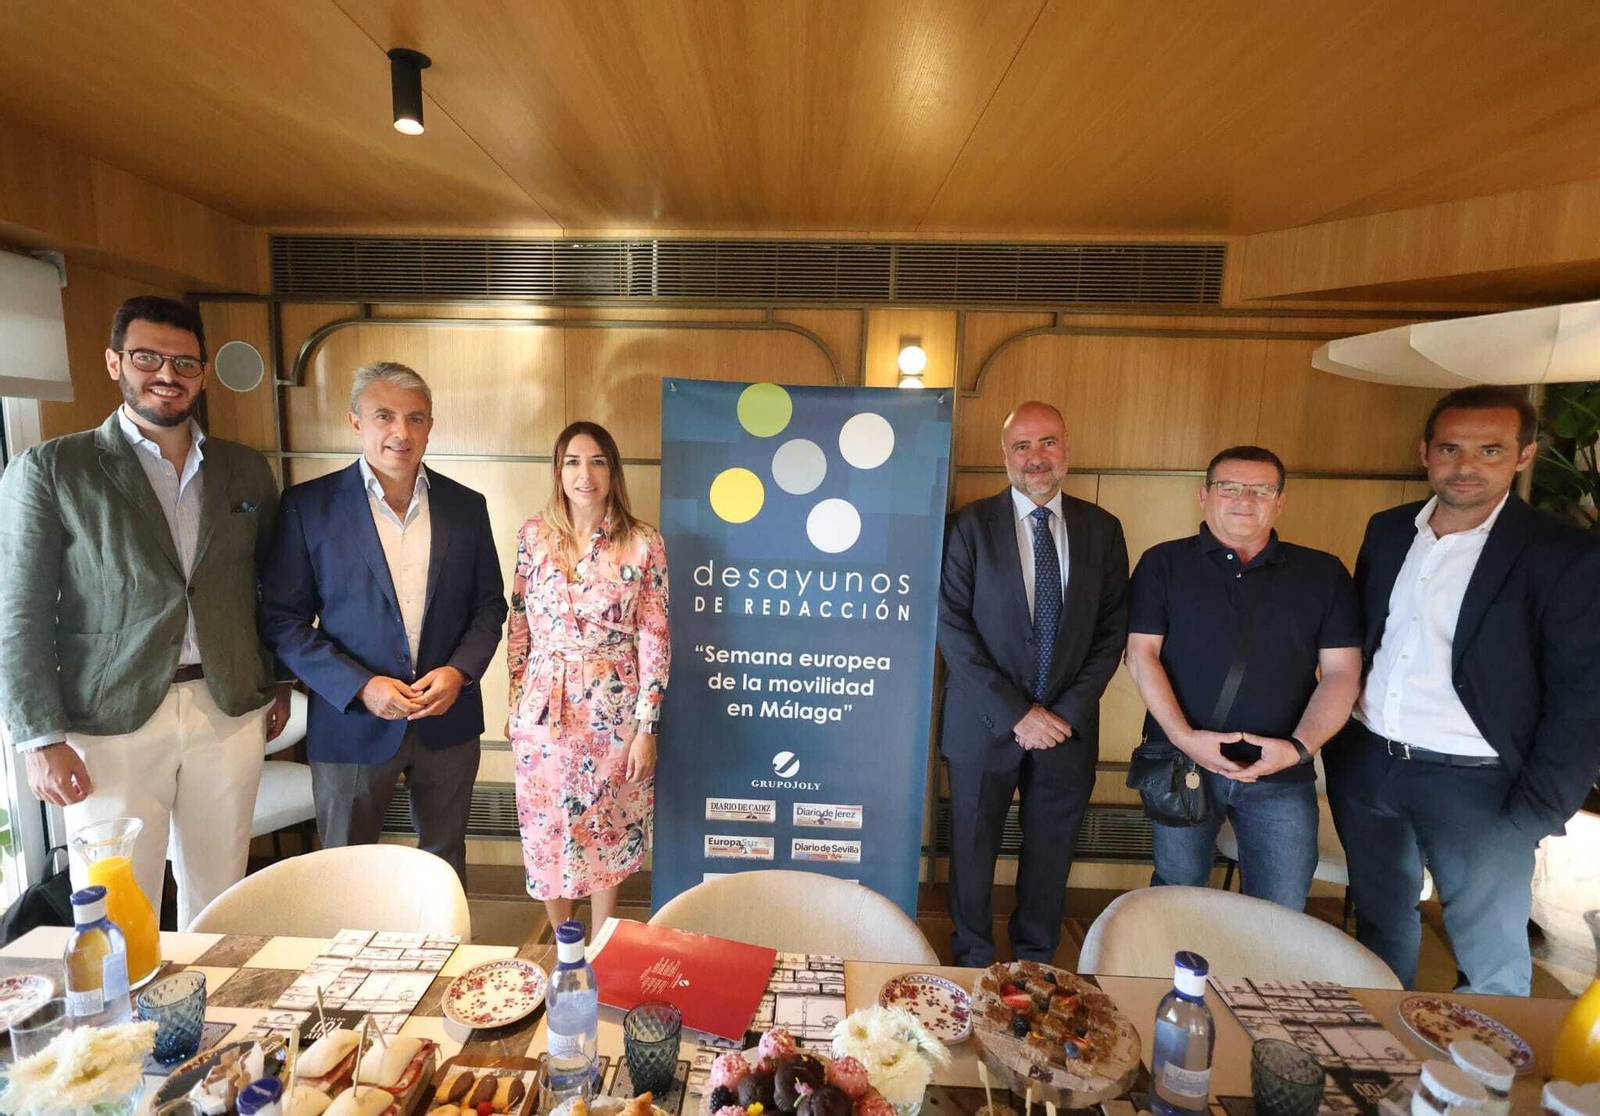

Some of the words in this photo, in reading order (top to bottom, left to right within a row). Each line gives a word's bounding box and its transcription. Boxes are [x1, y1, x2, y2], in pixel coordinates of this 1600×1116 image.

[694, 560, 909, 596] desayunos
[695, 597, 722, 612] DE
[745, 595, 909, 621] REDACCIÓN
[696, 646, 792, 665] “Semana
[800, 654, 890, 672] europea
[709, 673, 736, 689] de
[743, 674, 761, 690] la
[769, 677, 874, 696] movilidad
[728, 704, 752, 716] en
[760, 700, 852, 724] Málaga”
[752, 780, 820, 790] GRUPOJOLY
[710, 802, 737, 810] DIARIO
[796, 807, 821, 817] Diario
[823, 809, 834, 817] de
[834, 807, 856, 820] Jerez
[794, 843, 820, 851] Diario
[820, 844, 831, 852] de
[831, 845, 859, 853] Sevilla
